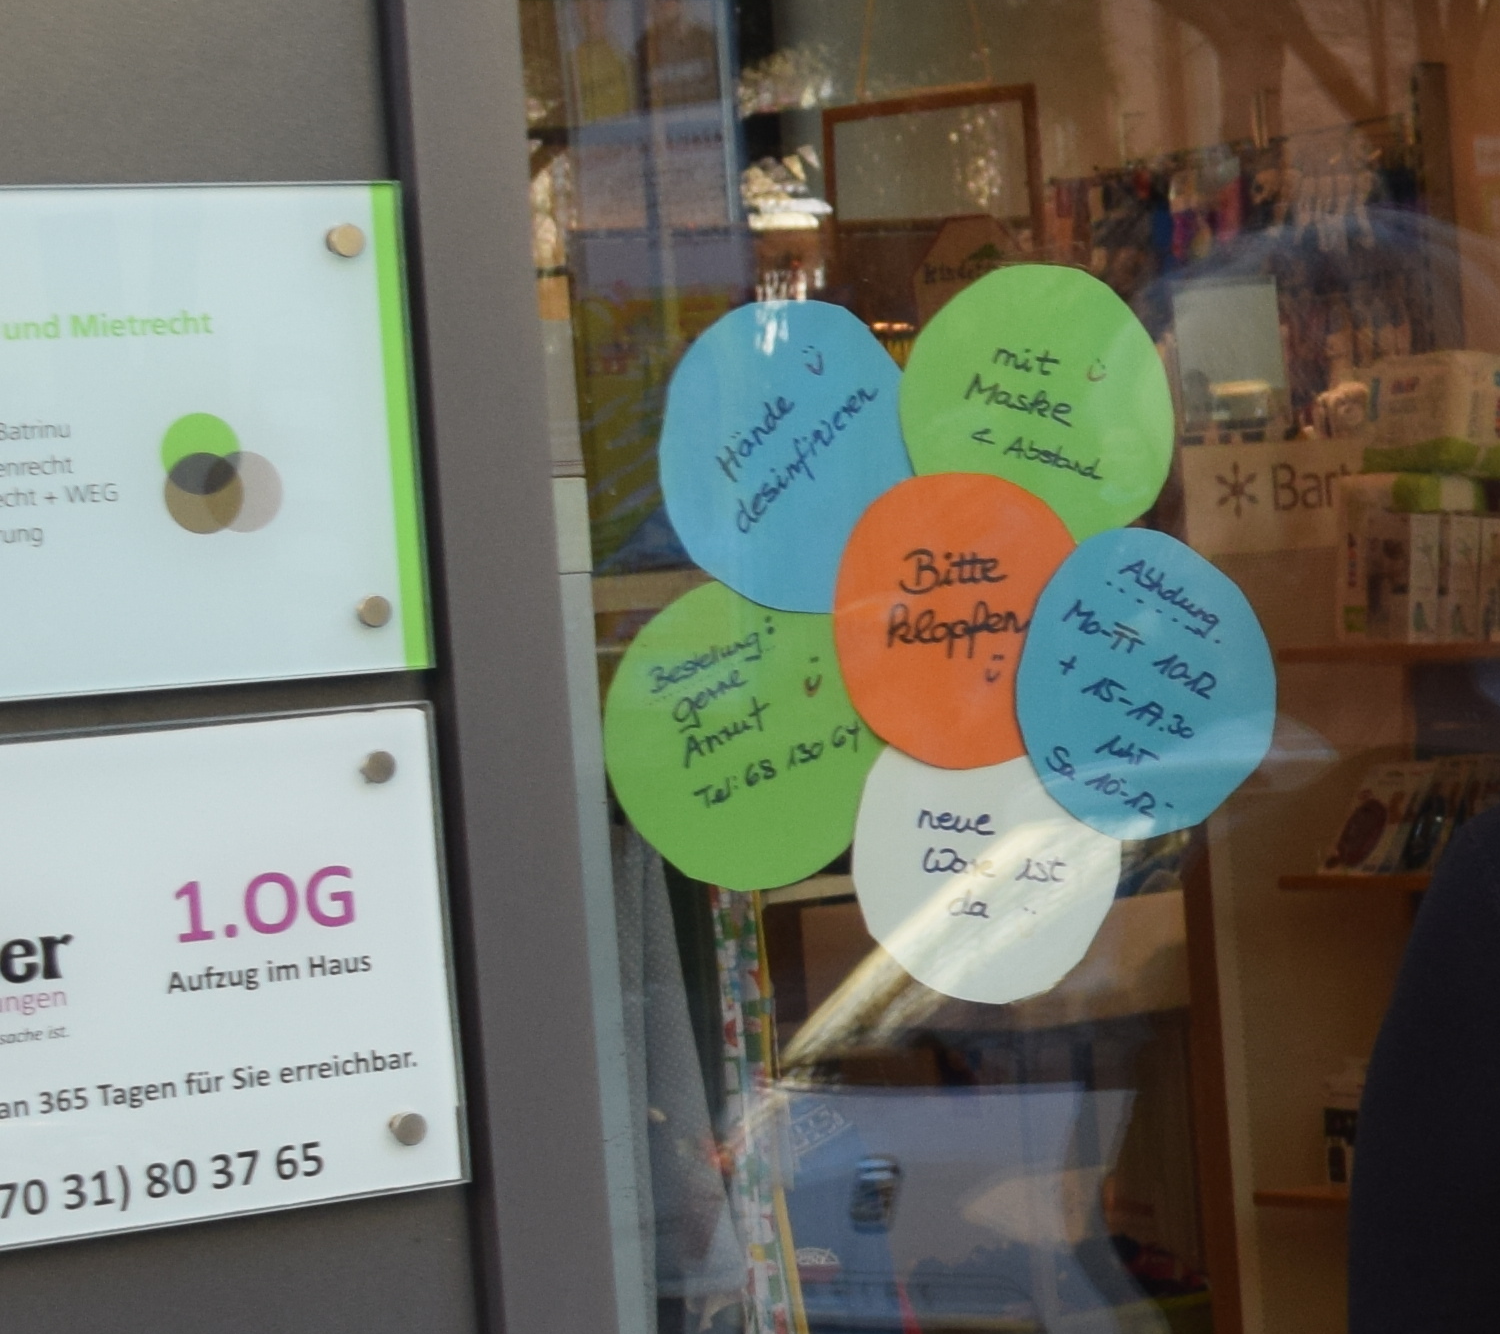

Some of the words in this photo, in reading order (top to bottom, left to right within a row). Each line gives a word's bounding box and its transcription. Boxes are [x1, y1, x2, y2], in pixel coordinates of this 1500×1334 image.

[2, 314, 61, 341] und
[69, 310, 215, 339] Mietrecht
[991, 347, 1061, 377] mit
[964, 373, 1073, 428] Maske
[715, 395, 796, 484] Hände
[64, 482, 120, 504] WEG
[898, 548, 1009, 595] Bitte
[887, 601, 1033, 659] klopfen
[745, 758, 777, 787] 68
[917, 809, 996, 836] neue
[173, 864, 357, 944] 1.OG
[948, 888, 990, 919] da
[166, 964, 260, 995] Aufzug
[267, 960, 301, 983] im
[308, 953, 373, 979] Haus
[38, 1086, 90, 1116] 365
[98, 1078, 178, 1110] Tagen
[184, 1072, 225, 1097] für
[231, 1065, 272, 1091] Sie
[279, 1048, 418, 1085] erreichbar.
[62, 1165, 133, 1213] 31)
[145, 1159, 198, 1199] 80
[210, 1150, 260, 1191] 37
[275, 1140, 325, 1181] 65
